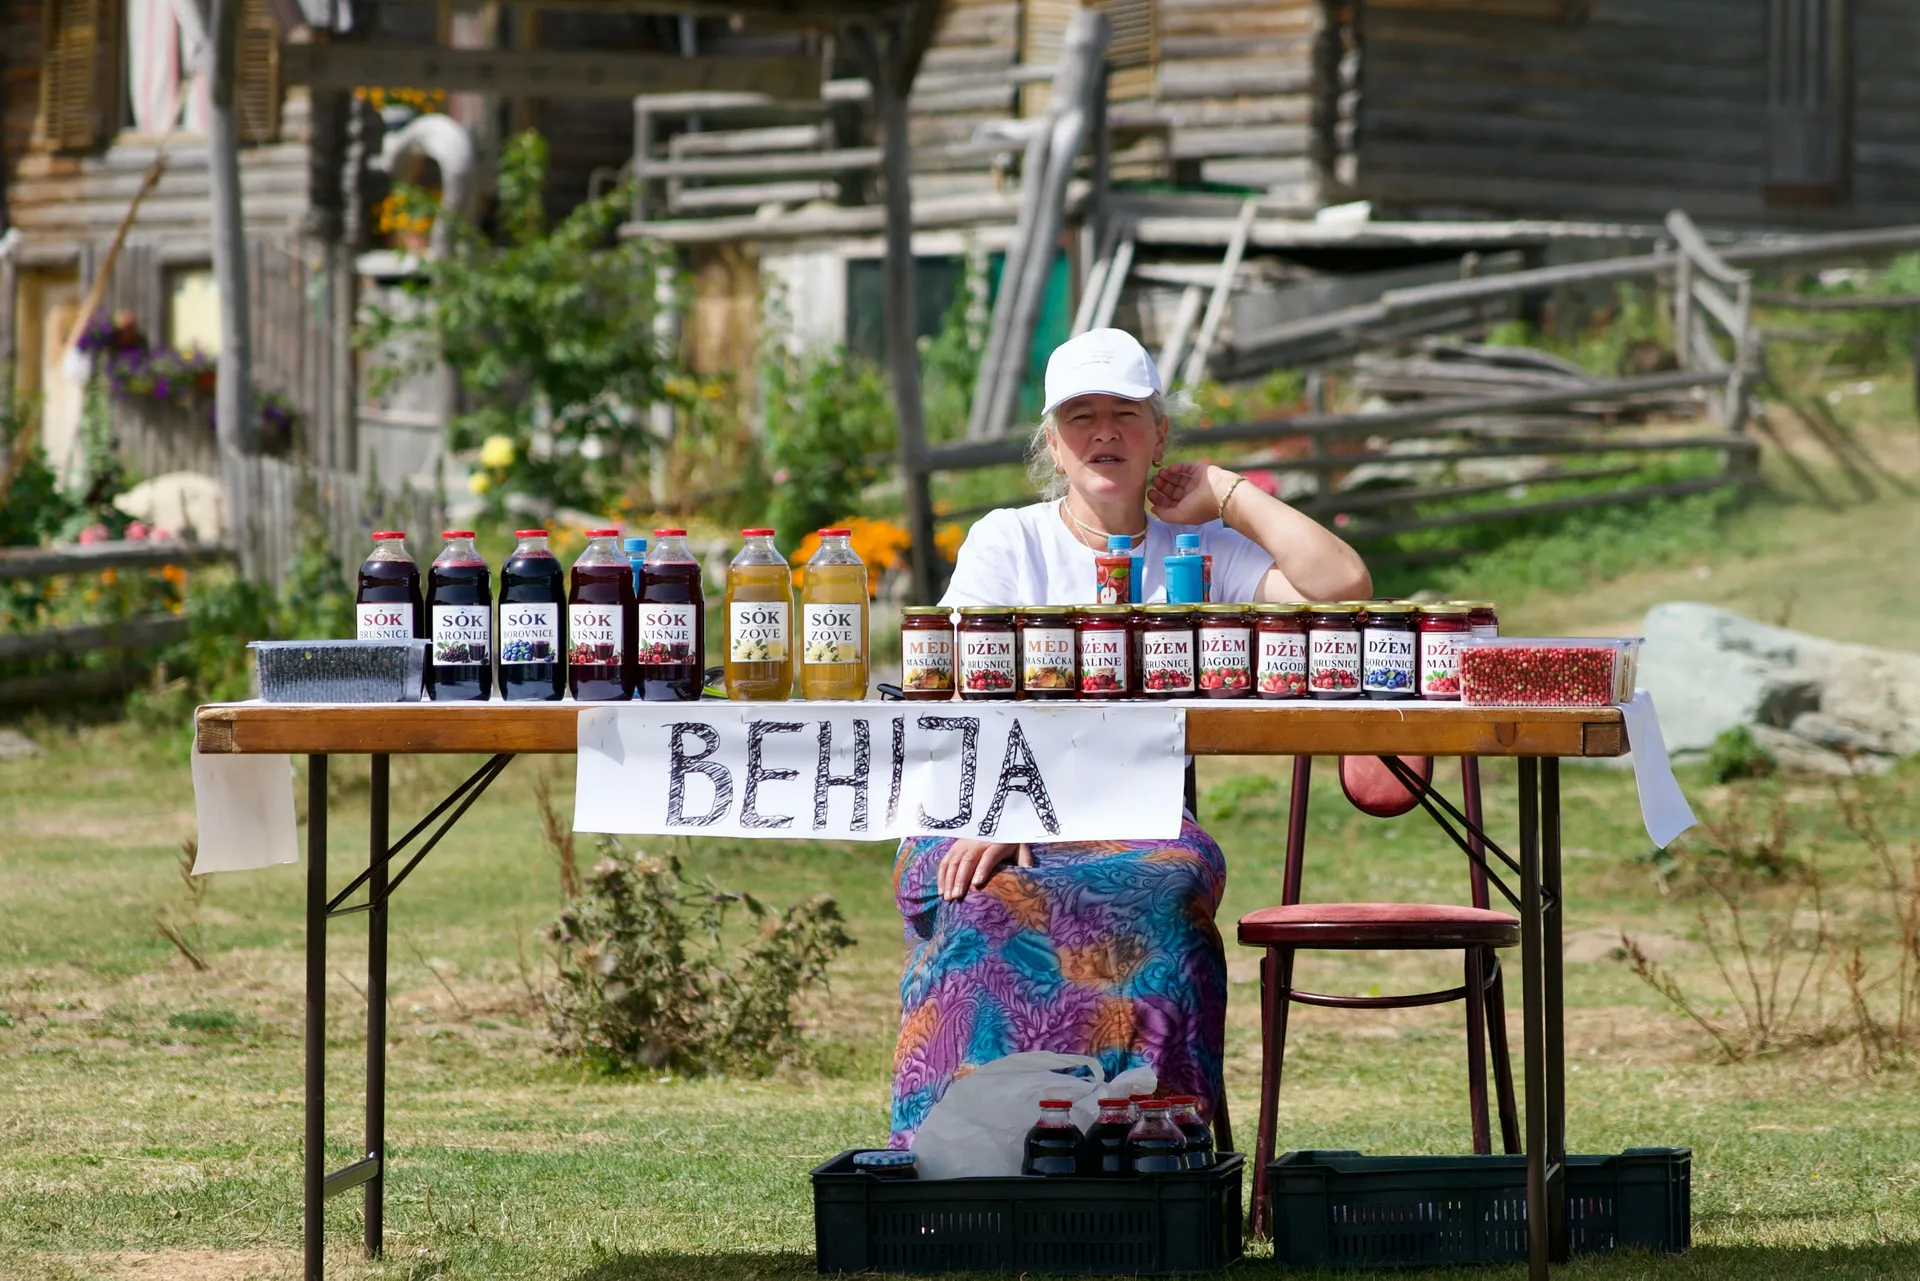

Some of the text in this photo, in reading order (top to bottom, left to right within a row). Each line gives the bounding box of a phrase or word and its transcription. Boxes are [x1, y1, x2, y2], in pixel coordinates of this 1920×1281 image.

[364, 614, 403, 626] SOK
[442, 615, 483, 627] SOK
[508, 614, 547, 626] SOK
[574, 614, 612, 626] SOK
[646, 614, 687, 626] SOK
[740, 611, 780, 624] SOK
[812, 613, 851, 626] SOK
[360, 630, 408, 639] BRUSNICE
[437, 630, 488, 640] ARONIJE
[504, 629, 554, 638] BOROVNICE
[572, 629, 613, 640] VIŠNJE
[644, 629, 688, 640] VIŠNJE
[740, 629, 780, 638] ZOVE
[812, 631, 852, 640] ZOVE
[910, 641, 950, 654] MED
[968, 640, 1010, 654] DŽEM
[1028, 640, 1069, 652] MED
[1145, 640, 1188, 654] DŽEM
[1202, 636, 1246, 652] DŽEM
[1314, 639, 1357, 654] DŽEM
[1369, 639, 1411, 654] DŽEM
[1428, 642, 1458, 655] DŽE
[906, 657, 952, 666] MASLAČKA
[968, 660, 1011, 668] BRUSNICE
[1025, 656, 1072, 665] MASLAČKA
[1146, 659, 1189, 668] BRUSNICE
[1202, 656, 1246, 667] JAGODE
[1314, 660, 1357, 668] BRUSNICE
[1366, 658, 1413, 668] BOROVNICE
[661, 712, 1060, 836] BEHIJA
